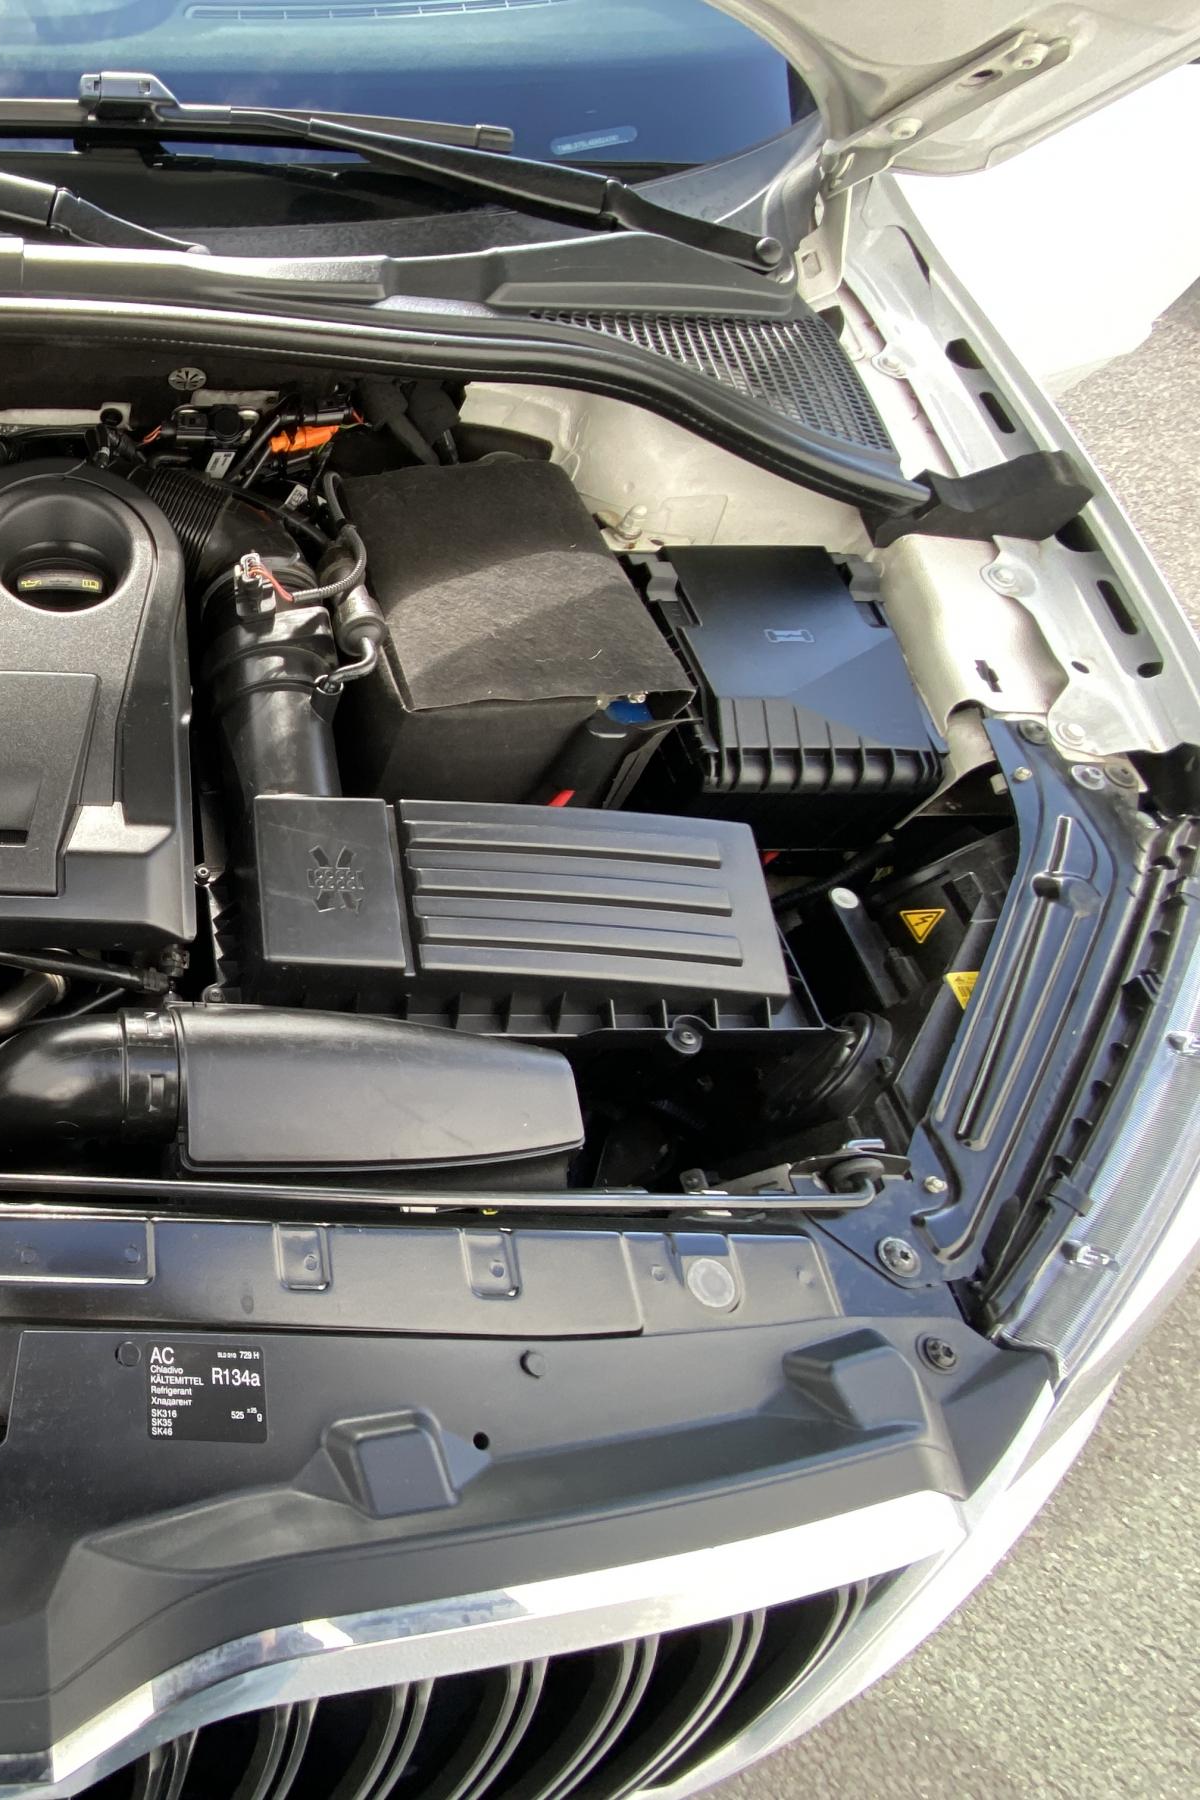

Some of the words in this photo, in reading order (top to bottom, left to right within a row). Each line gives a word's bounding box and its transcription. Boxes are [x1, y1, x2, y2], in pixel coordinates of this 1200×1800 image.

[150, 1346, 175, 1365] AC
[239, 1350, 253, 1360] 729
[253, 1351, 260, 1360] H
[150, 1364, 184, 1375] Chladivo
[150, 1374, 205, 1386] KÄLTEMITTEL
[211, 1367, 261, 1387] R134a
[150, 1385, 192, 1397] Refrigerant
[151, 1396, 193, 1407] Хладагент
[151, 1408, 178, 1418] SK316
[231, 1410, 245, 1420] 525
[256, 1413, 263, 1423] g
[151, 1417, 173, 1428] SK35
[151, 1426, 174, 1437] SK46
